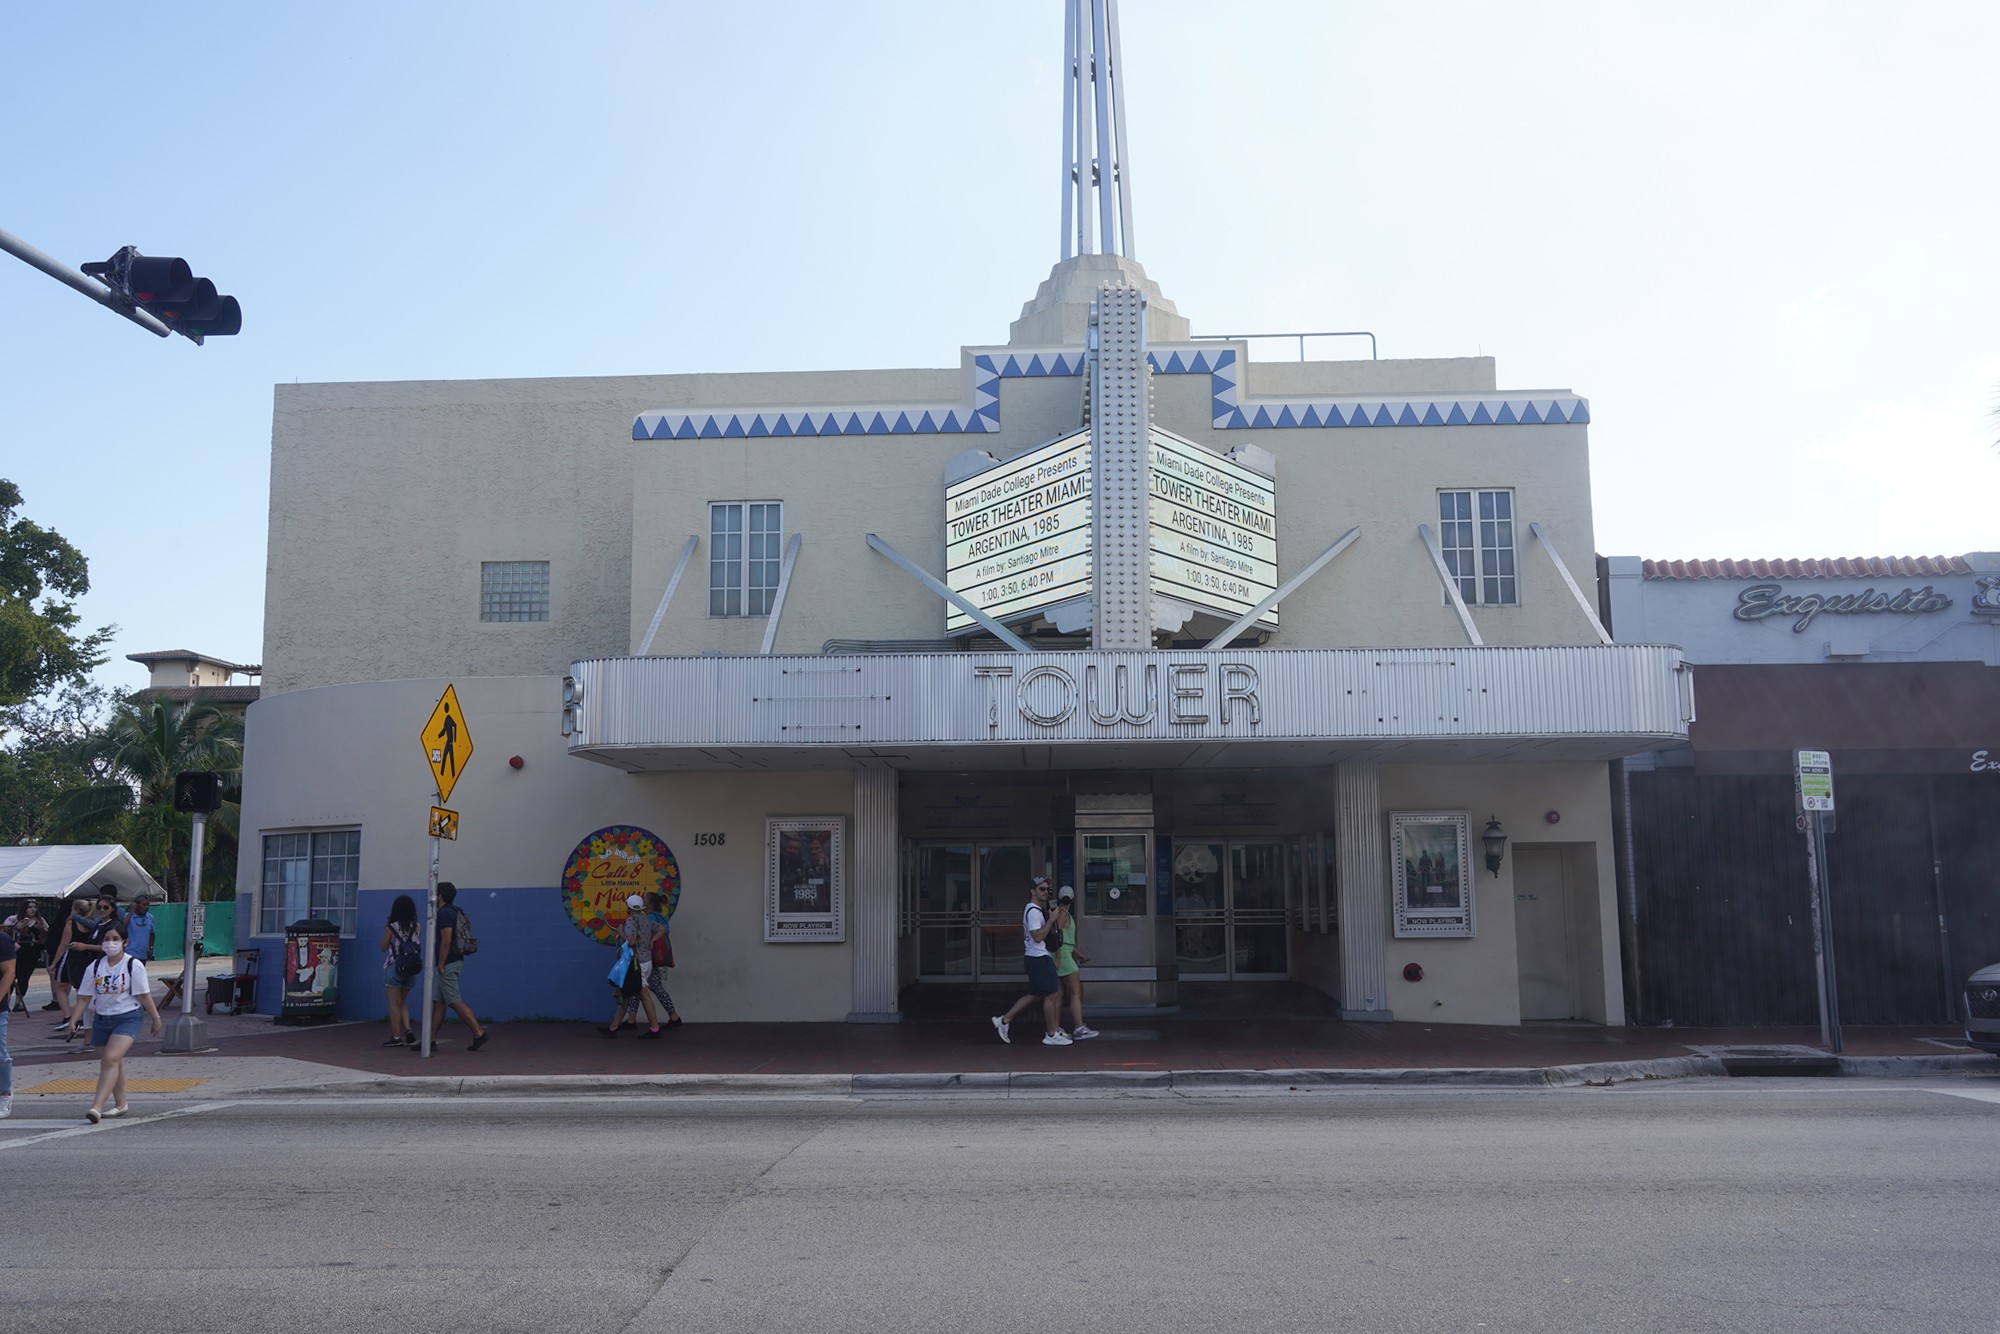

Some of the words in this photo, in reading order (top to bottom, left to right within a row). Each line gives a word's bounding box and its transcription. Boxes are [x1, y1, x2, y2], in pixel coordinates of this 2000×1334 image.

[955, 493, 979, 513] Miami
[981, 486, 1001, 502] Dade
[1003, 472, 1035, 494] College
[1037, 457, 1077, 480] Presents
[1156, 451, 1182, 468] Miami
[1184, 462, 1204, 482] Dade
[1206, 472, 1234, 493] College
[1235, 483, 1265, 506] Presents
[952, 513, 989, 539] TOWER
[991, 493, 1043, 525] THEATER
[1046, 476, 1085, 505] MIAMI
[1153, 474, 1192, 502] TOWER
[1194, 490, 1240, 522] THEATER
[1242, 511, 1272, 534] MIAMI
[968, 526, 1030, 558] ARGENTINA,
[1032, 513, 1060, 536] 1985
[1172, 511, 1230, 545] ARGENTINA,
[1232, 531, 1254, 552] 1985
[976, 569, 982, 579] A
[982, 564, 995, 577] film
[996, 561, 1006, 575] by:
[1007, 551, 1038, 569] Santiago
[1040, 544, 1059, 559] Mitre
[1180, 542, 1185, 551] A
[1186, 542, 1199, 556] film
[1200, 547, 1209, 561] by:
[1211, 552, 1237, 569] Santiago
[1238, 560, 1253, 574] Mitre
[982, 587, 999, 602] 1:00,
[1001, 581, 1020, 597] 3:50,
[1021, 576, 1038, 591] 6:40
[1040, 571, 1054, 586] PM
[1186, 569, 1203, 585] 1:00,
[1204, 574, 1221, 590] 3:50,
[1222, 578, 1237, 593] 6:40
[1238, 583, 1249, 598] PM
[1733, 584, 1953, 633] Exquisito
[974, 664, 1260, 727] TOWER
[694, 833, 726, 846] 1508
[592, 862, 628, 879] Calle
[629, 862, 645, 879] 8
[793, 888, 817, 899] 1985
